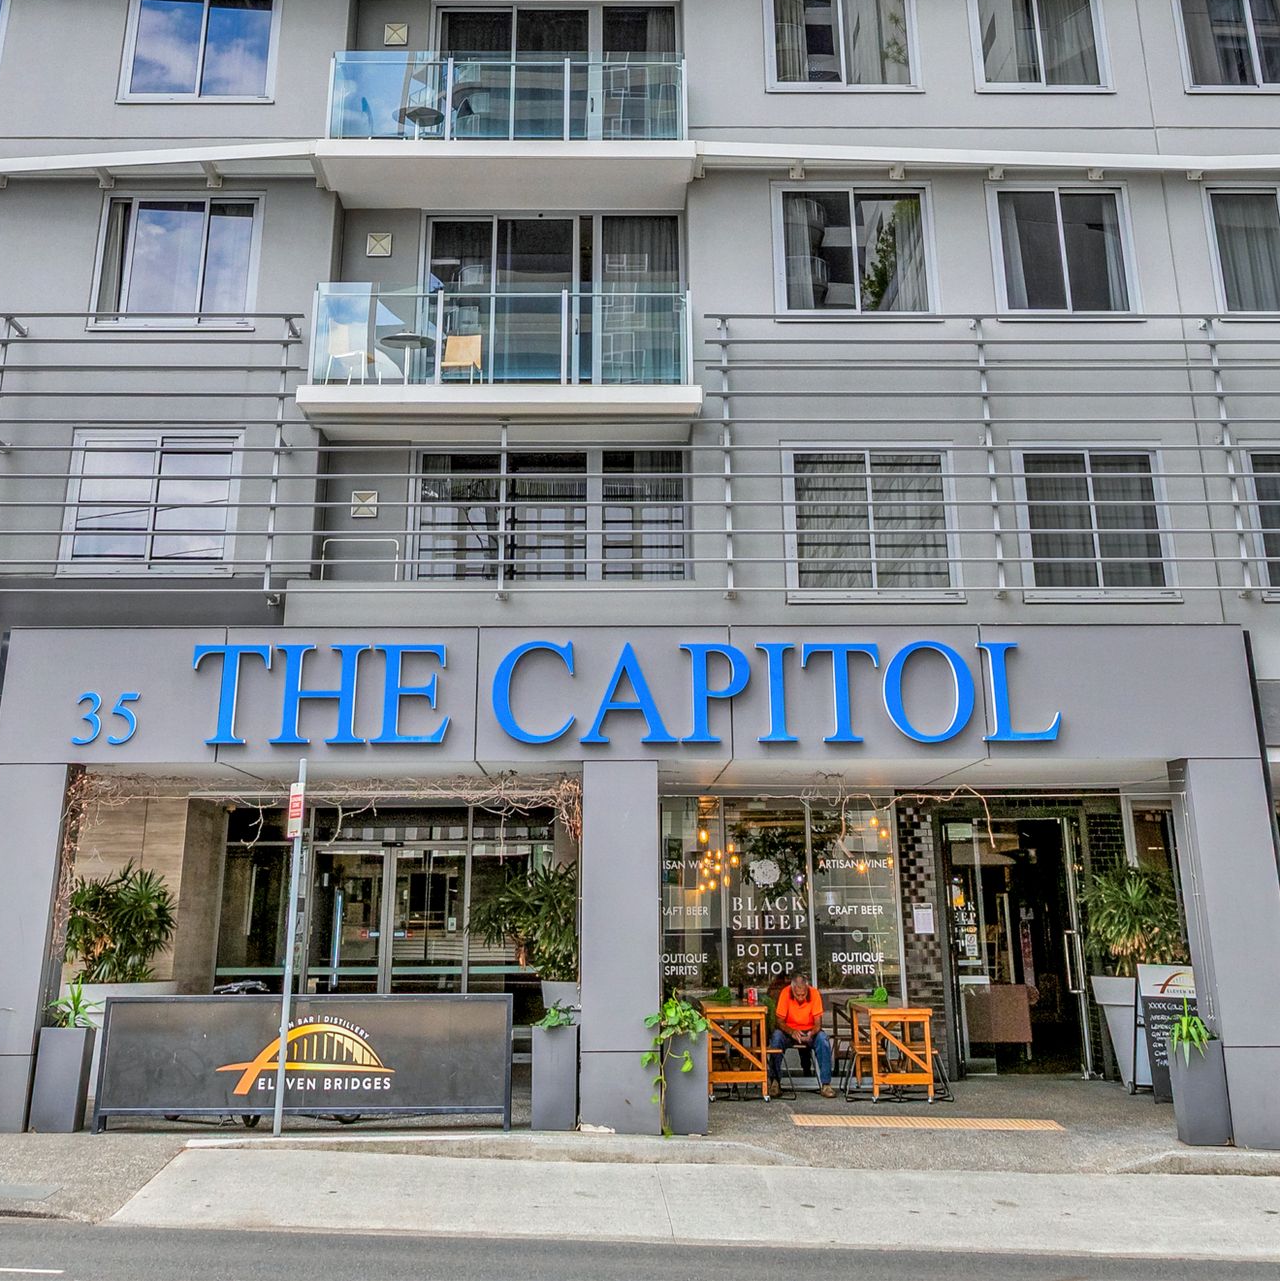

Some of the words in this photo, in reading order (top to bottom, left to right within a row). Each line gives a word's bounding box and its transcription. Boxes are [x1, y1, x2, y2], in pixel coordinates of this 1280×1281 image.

[193, 644, 451, 746] THE
[491, 640, 1062, 744] CAPITOL
[71, 691, 141, 746] 35
[819, 859, 859, 869] ARTISAN
[732, 896, 805, 912] BLACK
[828, 905, 858, 915] CRAFT
[861, 905, 884, 915] BEER
[686, 906, 709, 916] BEER
[732, 914, 806, 930] SHEEP
[736, 943, 803, 957] BOTTLE
[659, 953, 708, 963] OUTIQUE
[831, 952, 885, 963] BOUTIQUE
[664, 965, 698, 975] SPIRITS
[747, 961, 794, 975] SHOP
[841, 964, 876, 975] SPIRITS
[297, 1016, 314, 1026] BAR
[324, 1015, 370, 1040] DISTILLERY
[258, 1077, 316, 1090] ELVEN
[323, 1077, 392, 1090] BRIDGES
